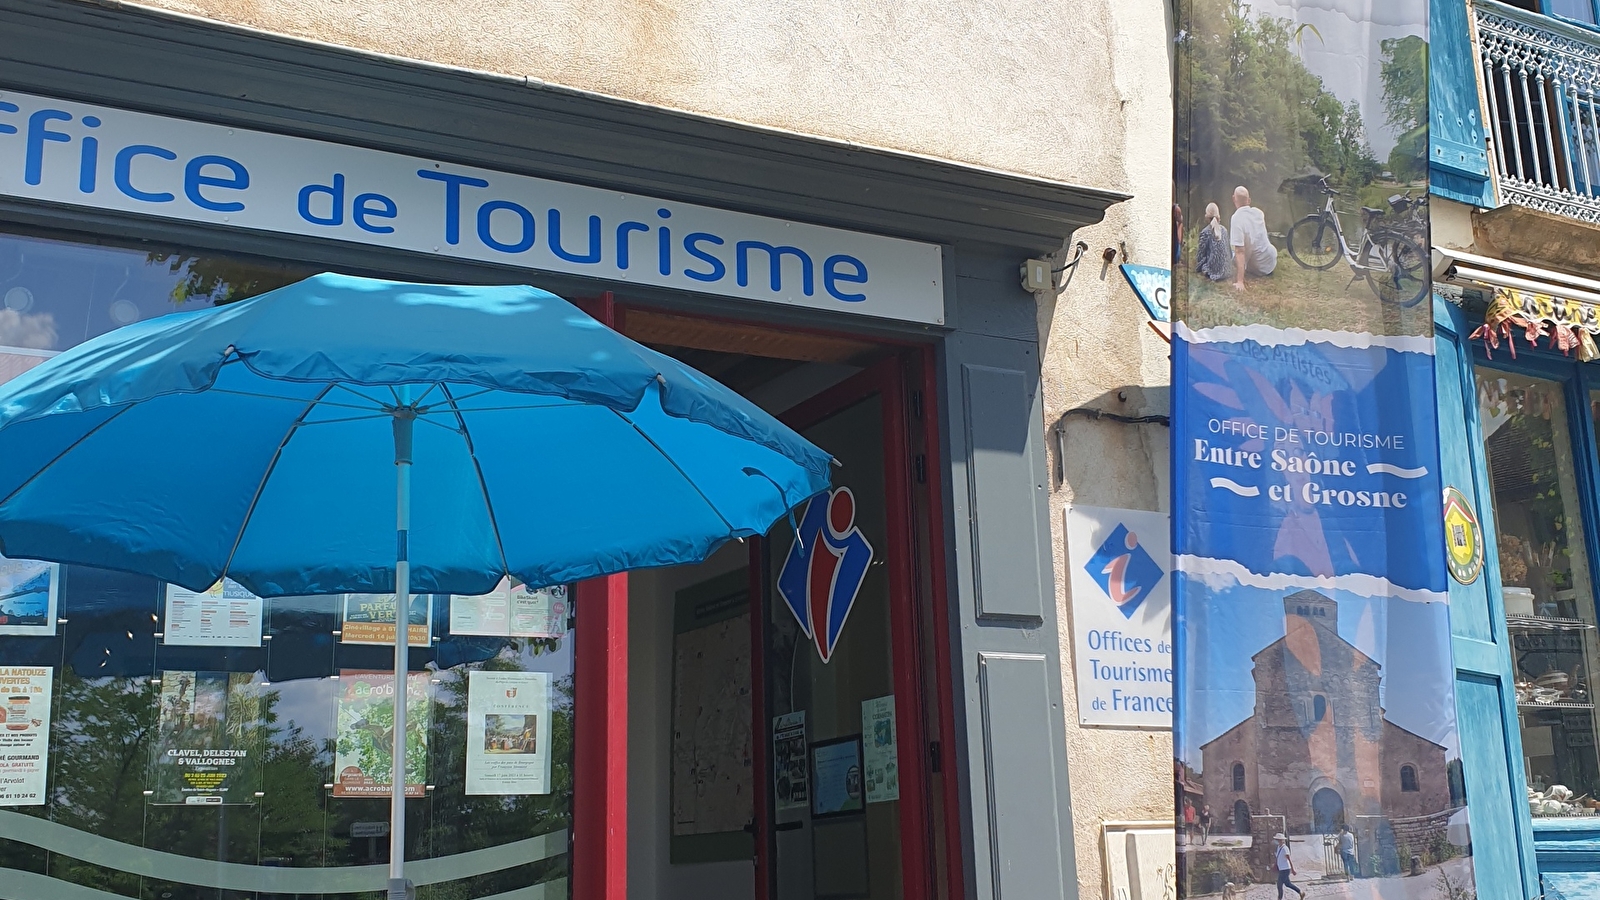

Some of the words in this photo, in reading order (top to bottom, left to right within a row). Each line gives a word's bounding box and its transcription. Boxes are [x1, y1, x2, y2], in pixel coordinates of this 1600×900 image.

[298, 173, 397, 234] de
[417, 169, 868, 303] Tourisme
[1208, 418, 1269, 440] OFFICE
[1274, 427, 1299, 443] DE
[1304, 429, 1405, 450] TOURISME
[1194, 438, 1262, 469] Entre
[1271, 449, 1356, 477] Saône
[1268, 483, 1292, 502] et
[1302, 482, 1407, 508] Grosne
[360, 602, 396, 612] PARFU
[1088, 629, 1152, 653] Offices
[1157, 640, 1171, 654] de
[1089, 659, 1172, 683] Tourisme
[355, 684, 414, 695] acro'bh
[1092, 697, 1107, 711] de
[1112, 689, 1173, 713] France
[167, 749, 203, 758] CLAVEL,
[185, 758, 236, 766] VALLOGNES
